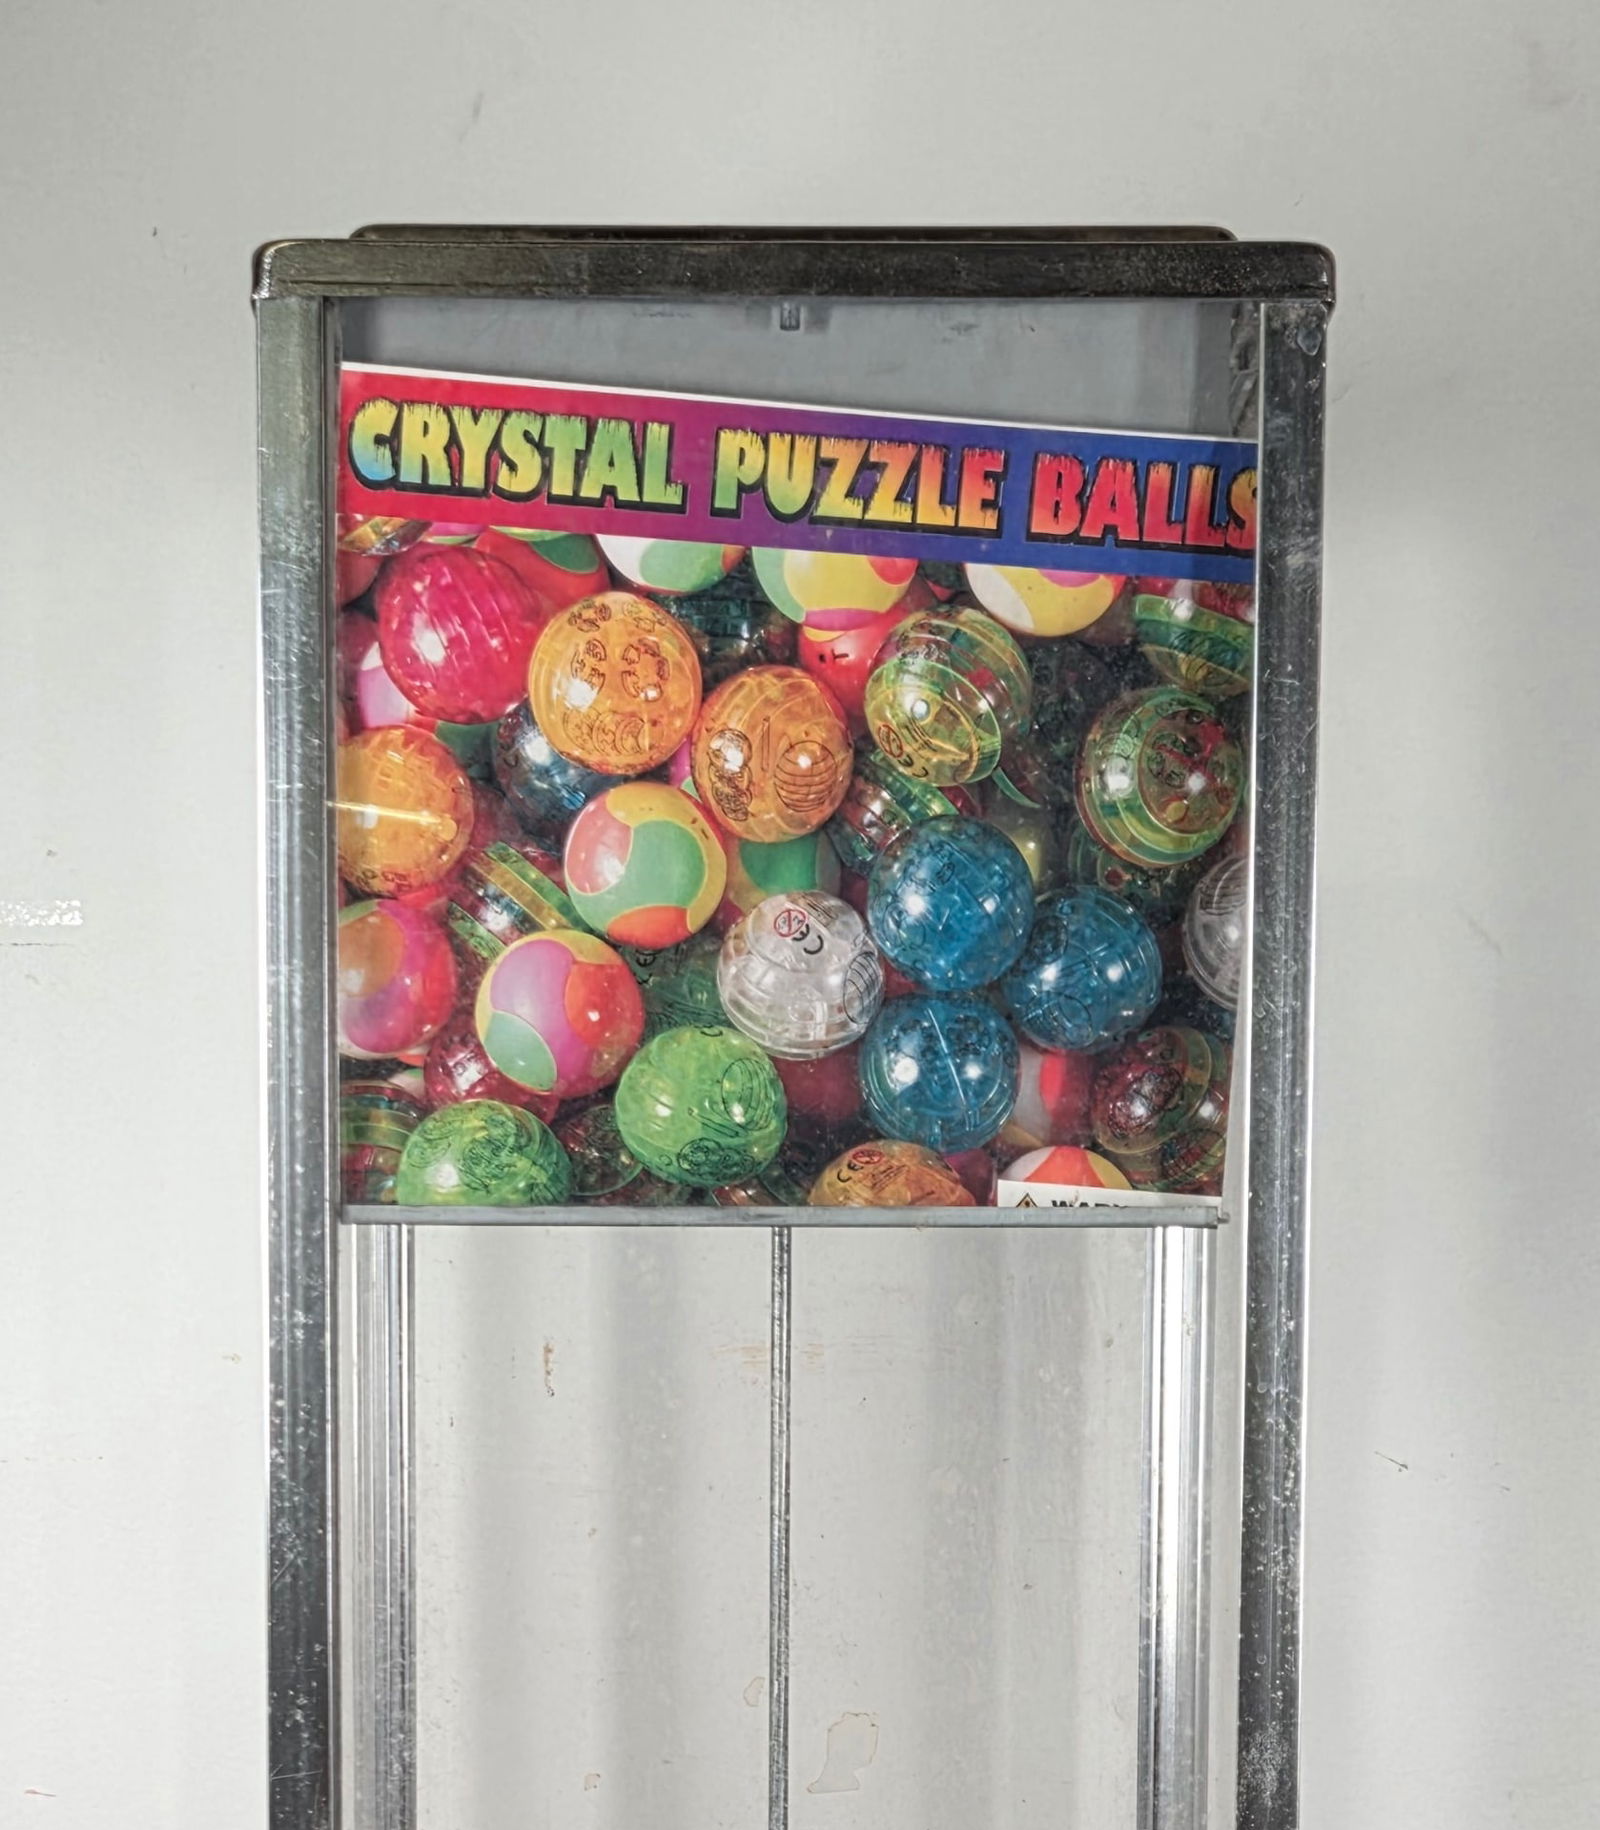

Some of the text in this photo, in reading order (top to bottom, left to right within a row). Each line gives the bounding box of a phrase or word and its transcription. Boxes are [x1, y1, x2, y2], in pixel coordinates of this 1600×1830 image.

[347, 396, 1258, 557] CRYSTAL PUZZLE BALLS
